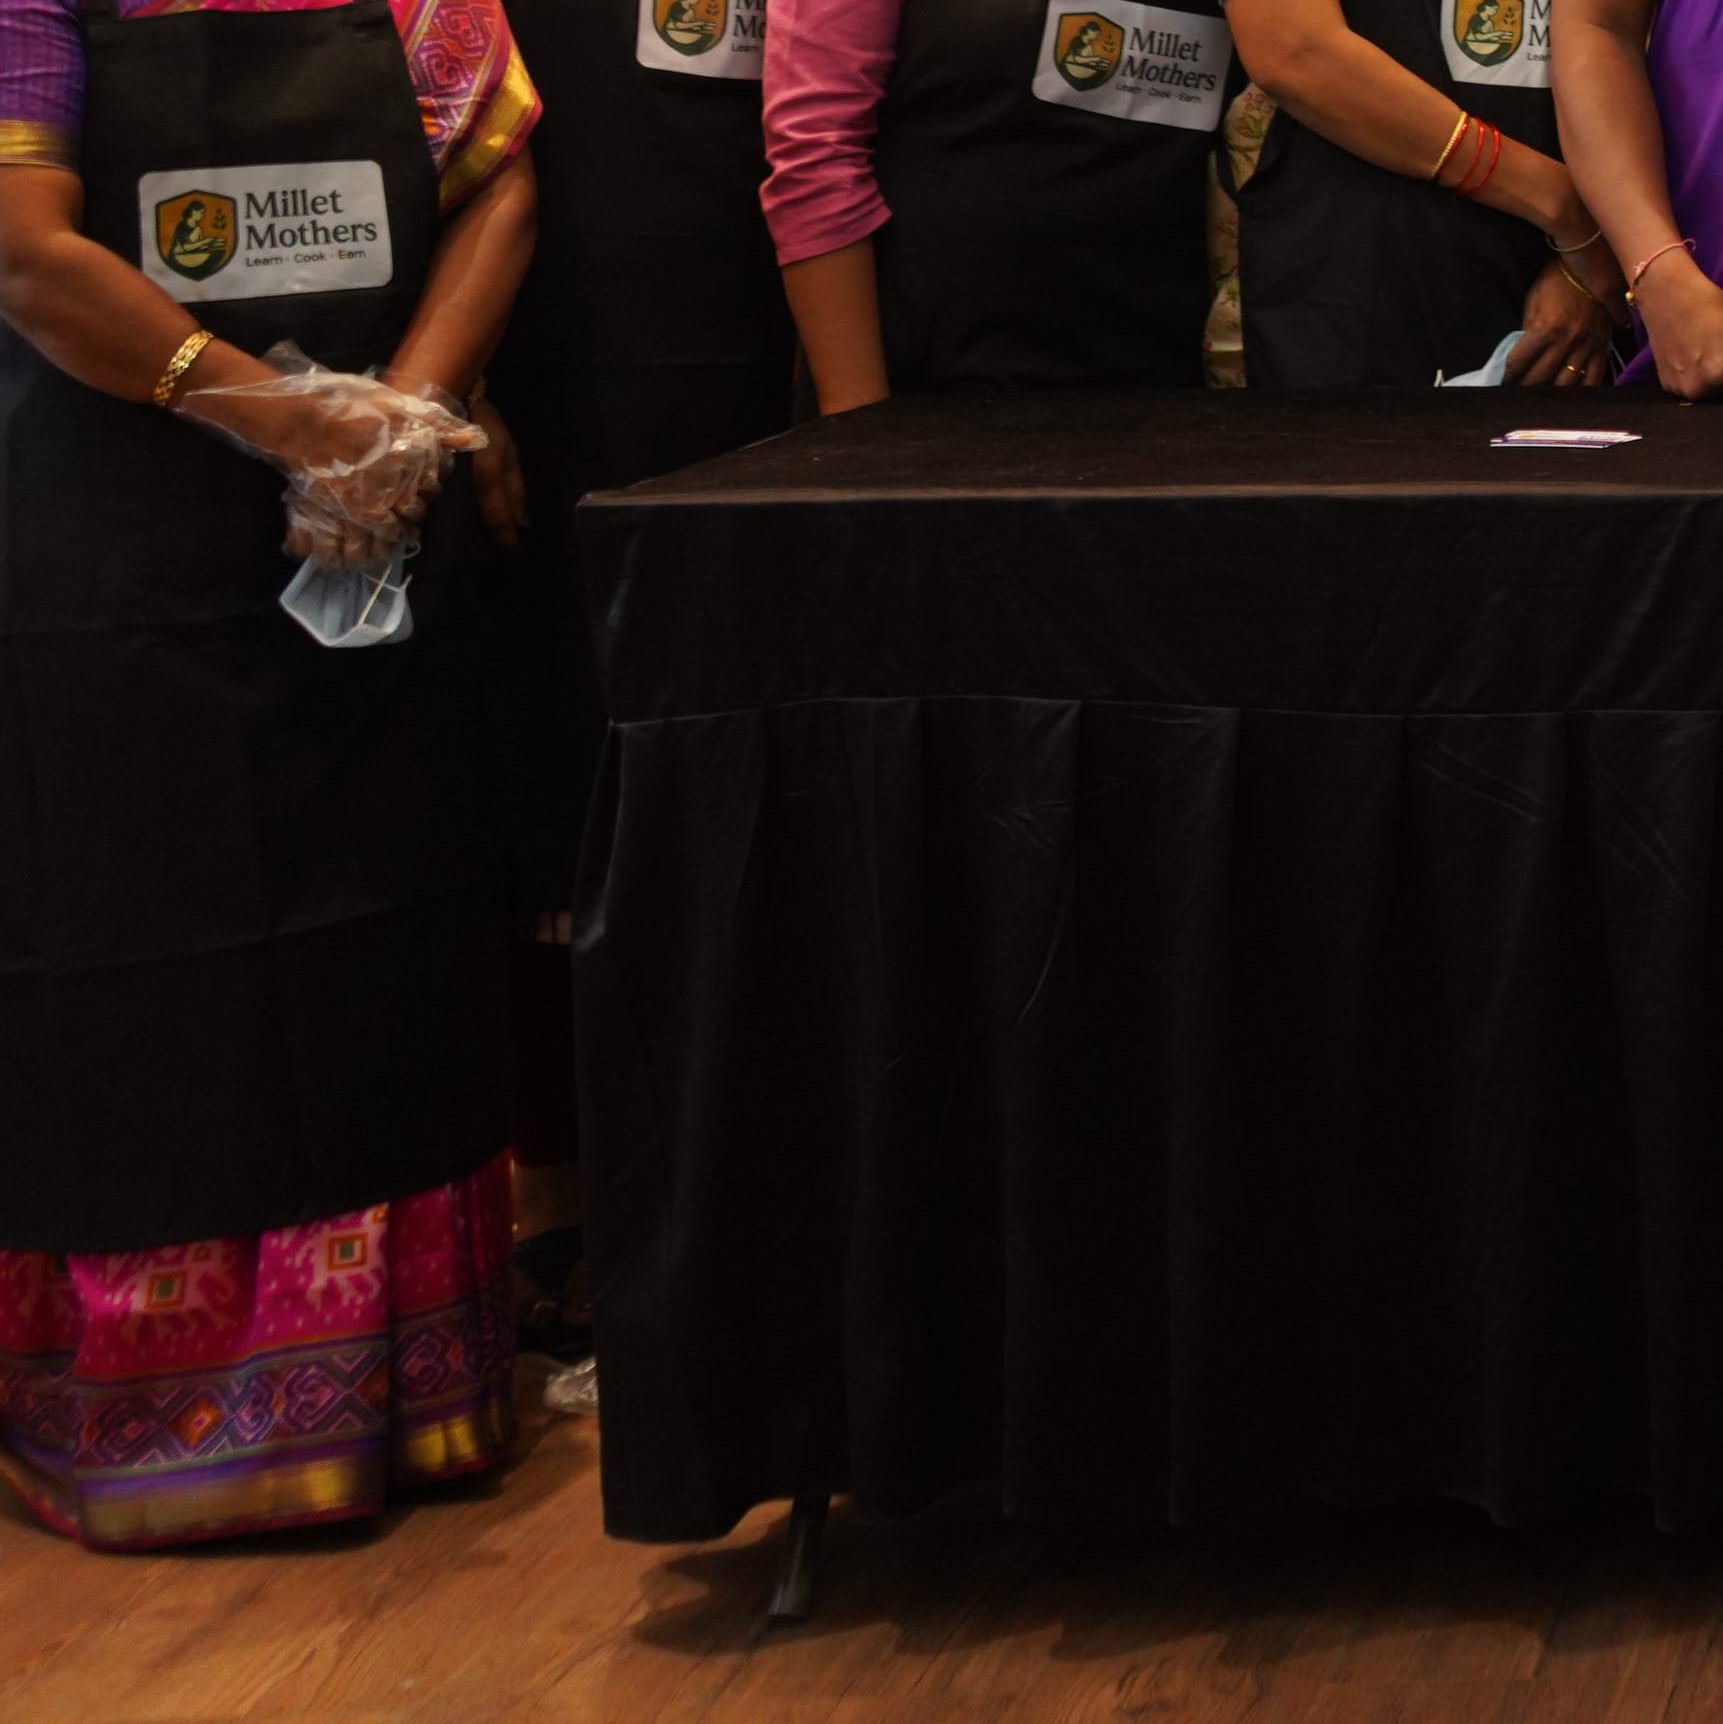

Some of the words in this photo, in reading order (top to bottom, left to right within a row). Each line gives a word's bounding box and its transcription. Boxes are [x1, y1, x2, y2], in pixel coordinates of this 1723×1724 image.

[1129, 26, 1203, 63] Millet
[1120, 54, 1218, 92] Mothers
[243, 188, 345, 220] Millet
[244, 219, 379, 251] Mothers
[245, 255, 284, 268] Learn
[294, 252, 327, 264] Cook
[338, 249, 367, 261] Earn
